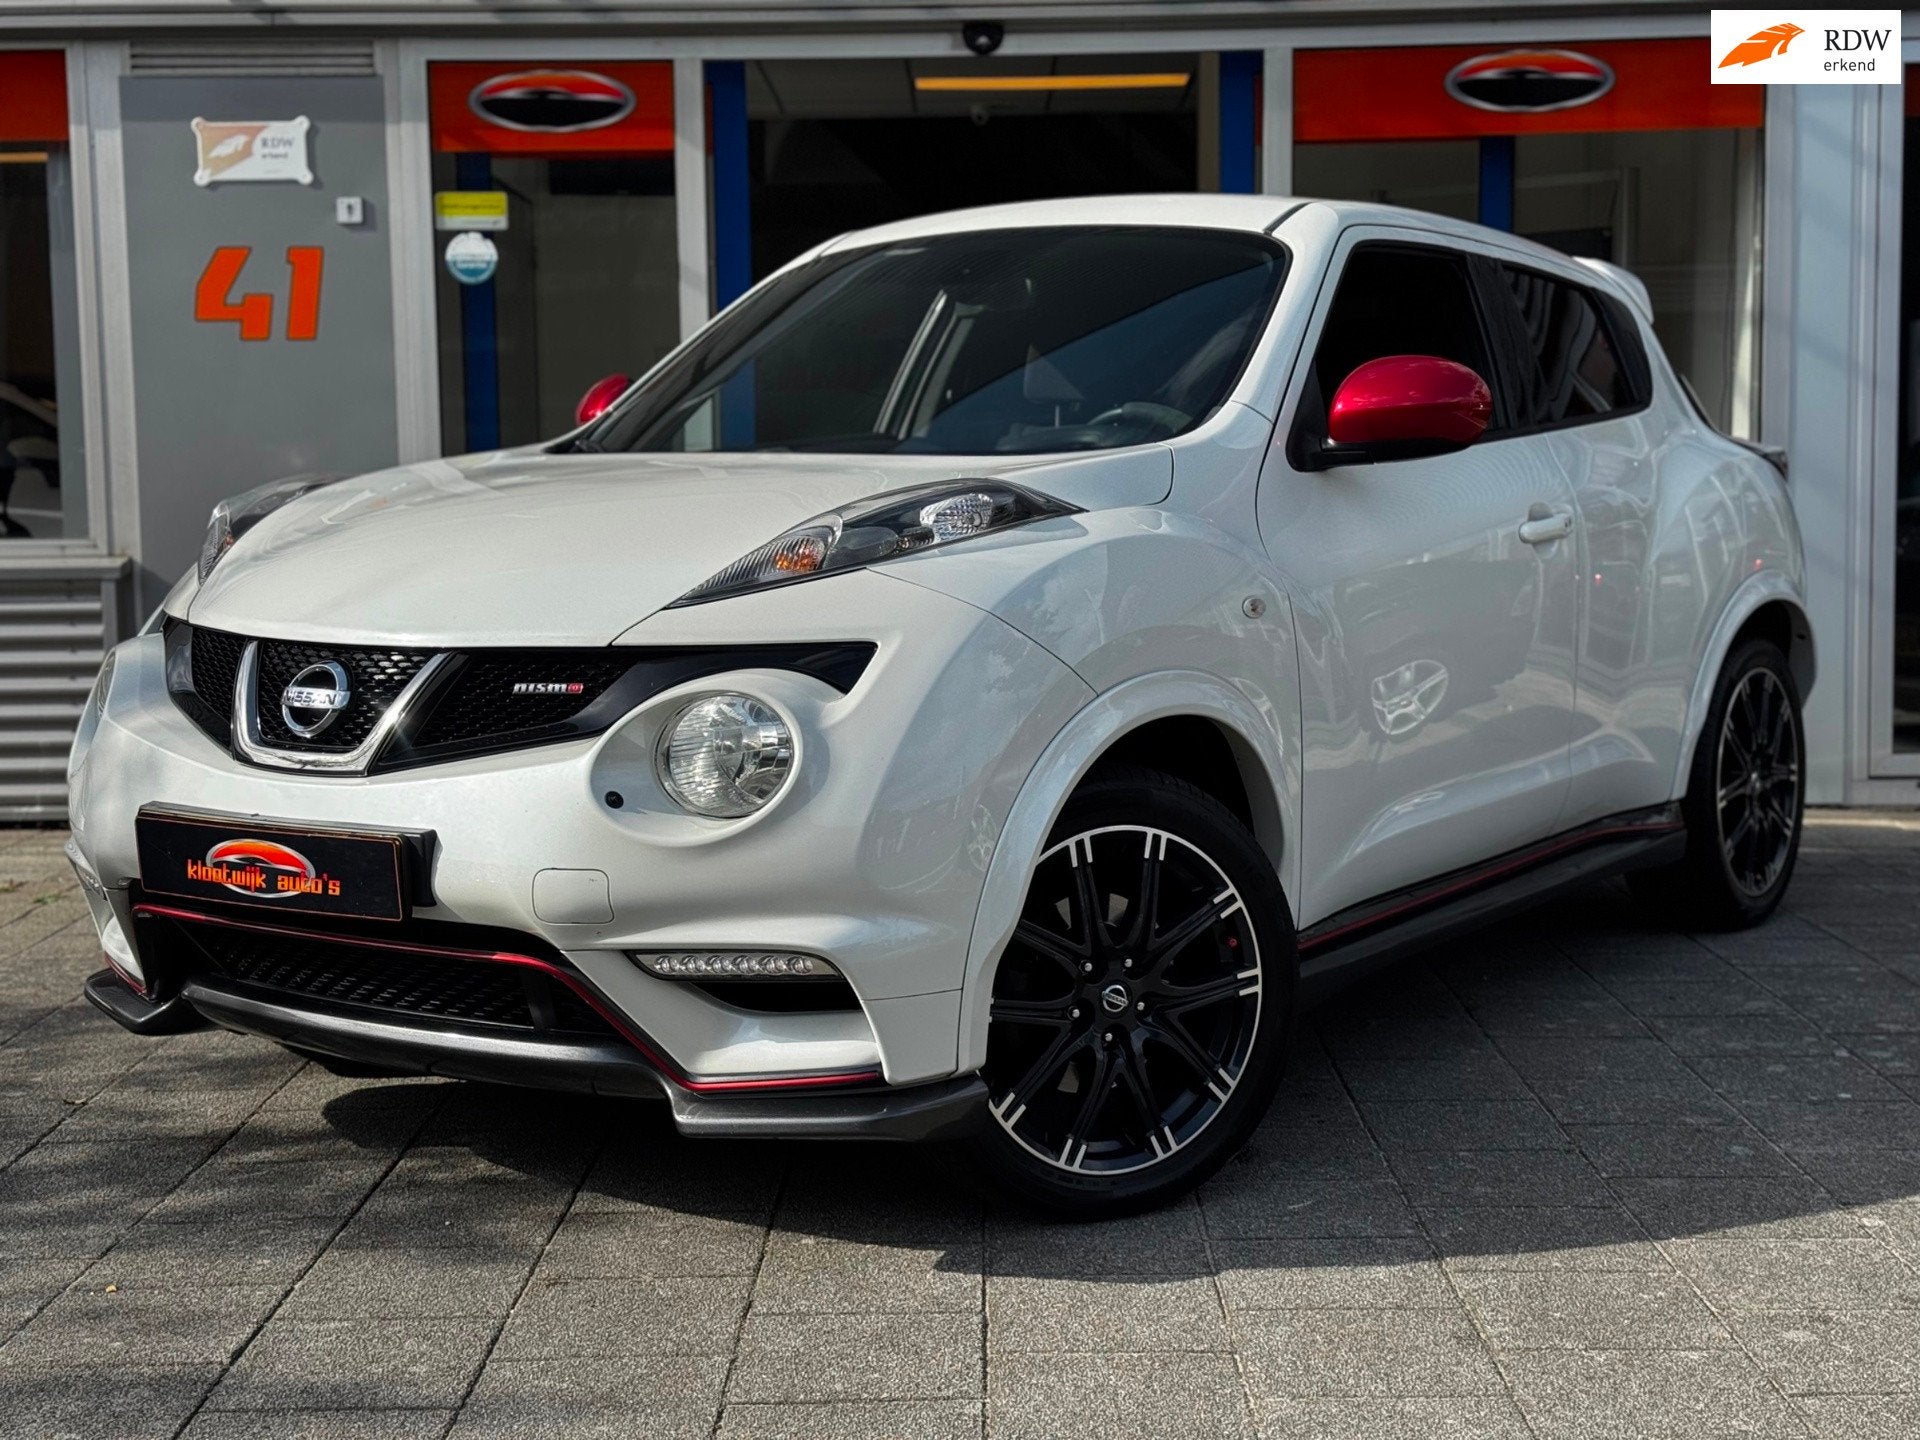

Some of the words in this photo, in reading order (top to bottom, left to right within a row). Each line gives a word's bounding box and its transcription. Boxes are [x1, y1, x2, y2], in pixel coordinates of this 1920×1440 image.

[194, 246, 325, 341] 41
[186, 859, 267, 893] klootwijk
[277, 870, 341, 897] auto's
